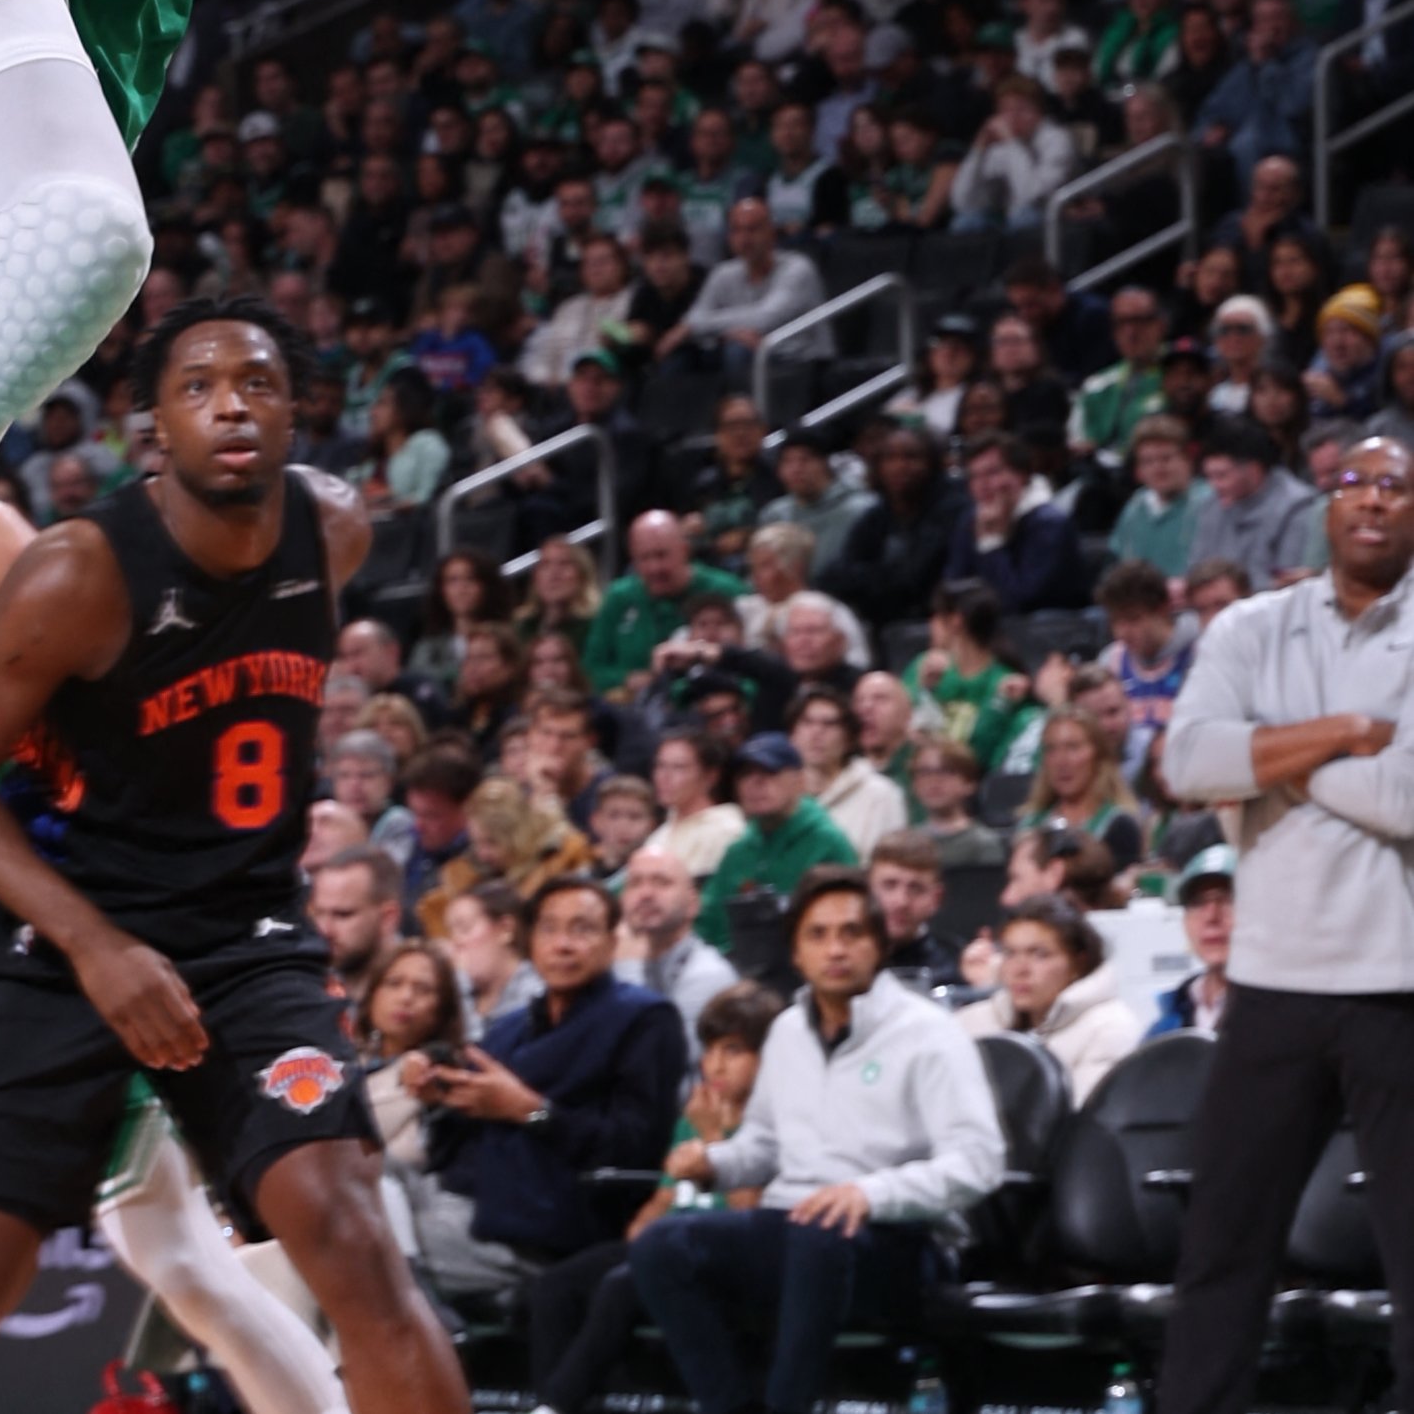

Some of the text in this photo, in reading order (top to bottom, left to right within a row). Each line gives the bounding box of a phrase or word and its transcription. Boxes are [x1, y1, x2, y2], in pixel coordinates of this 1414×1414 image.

[138, 649, 327, 737] NEW YORK
[215, 721, 284, 830] 8
